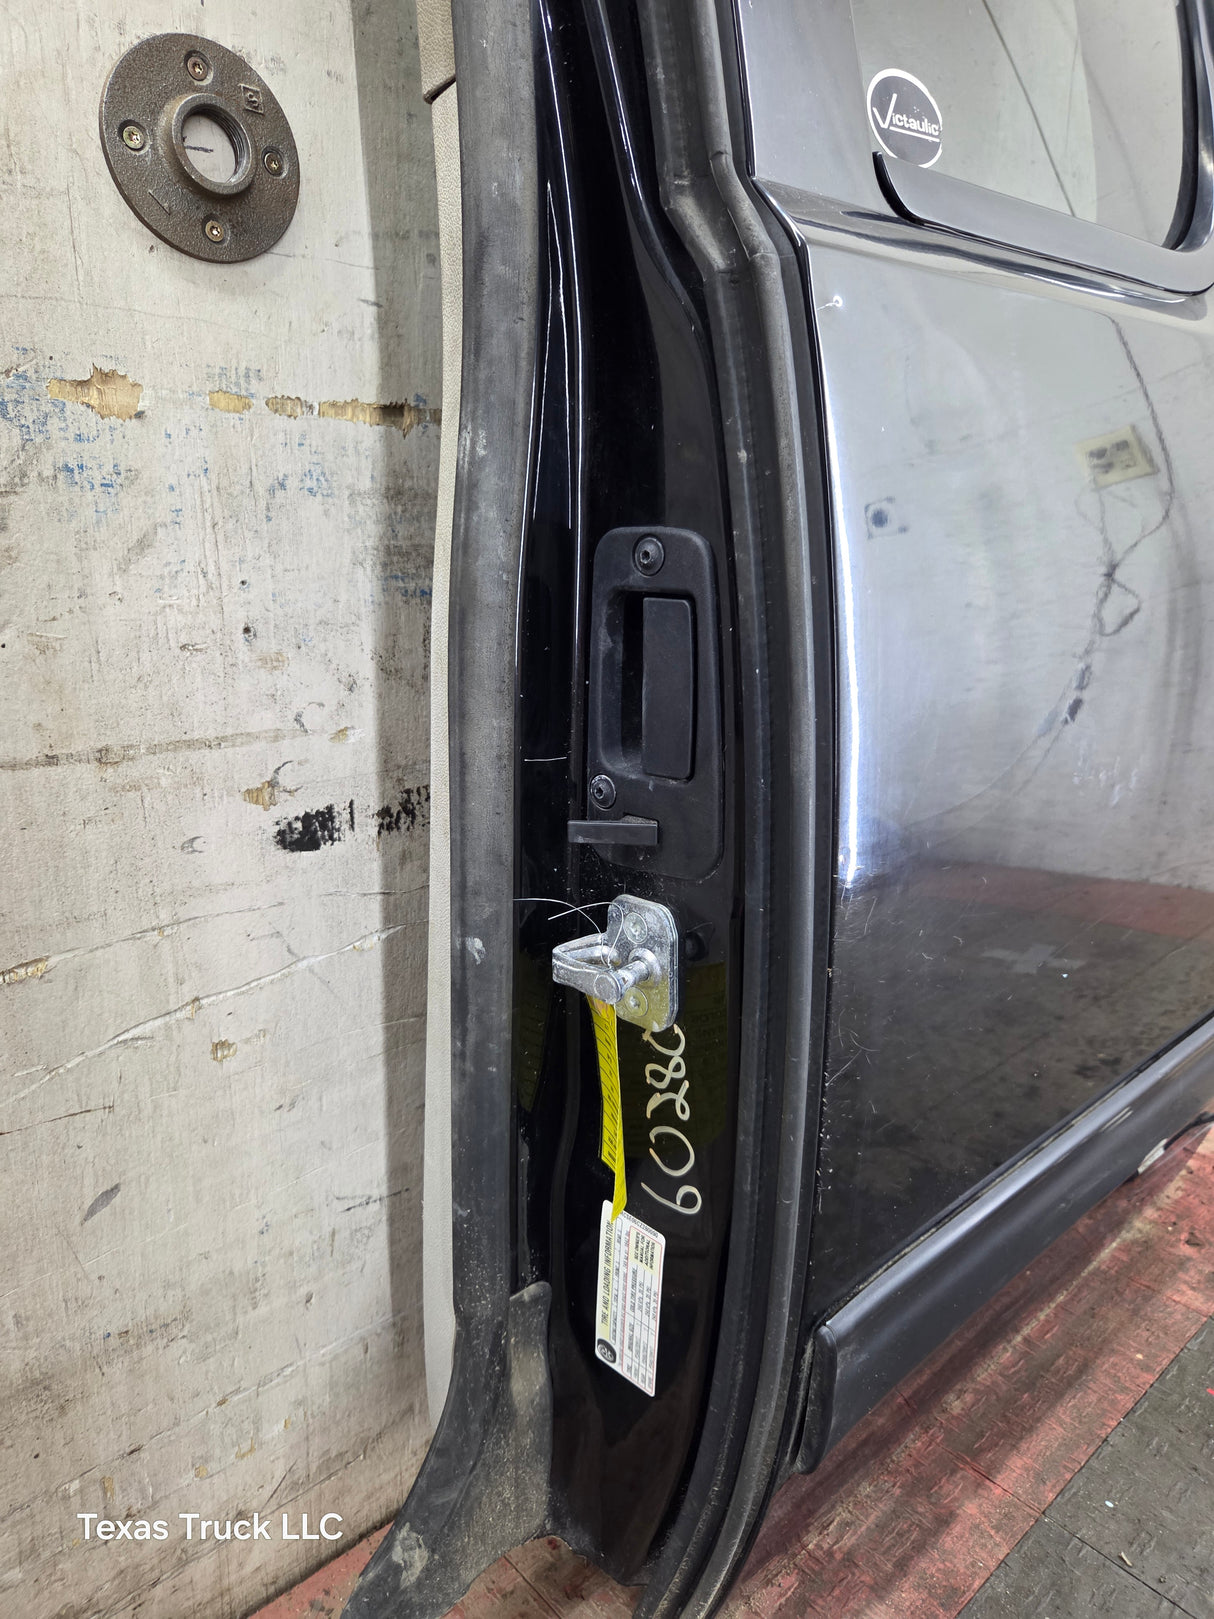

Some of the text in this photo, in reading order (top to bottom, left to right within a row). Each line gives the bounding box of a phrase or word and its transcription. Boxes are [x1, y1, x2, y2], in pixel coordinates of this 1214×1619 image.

[872, 93, 940, 136] Victaulic
[604, 1219, 613, 1267] INFORMATION
[602, 1265, 610, 1296] LOADING
